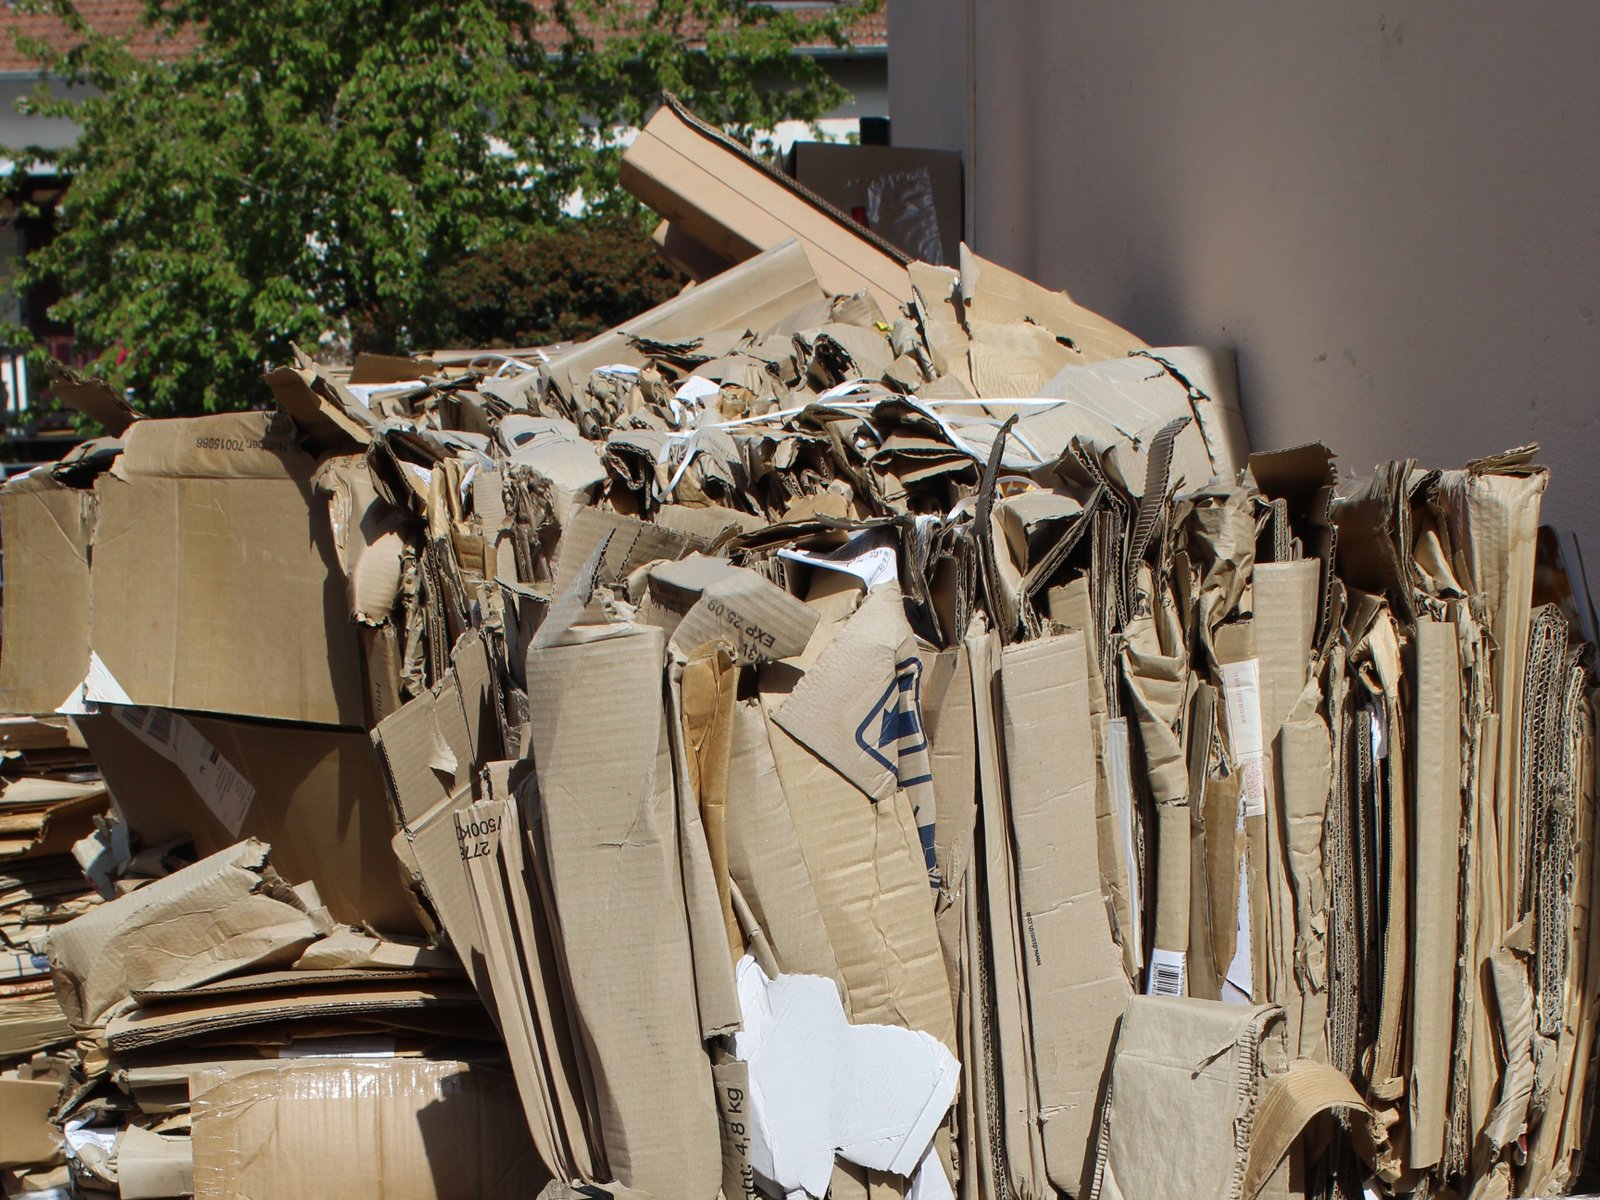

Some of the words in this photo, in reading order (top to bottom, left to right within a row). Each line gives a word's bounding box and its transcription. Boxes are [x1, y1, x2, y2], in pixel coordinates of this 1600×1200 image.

[196, 438, 244, 452] 70015986
[746, 626, 776, 648] EXP
[1026, 911, 1042, 967] www.dssmith.com
[727, 1087, 744, 1114] kg
[731, 1122, 751, 1157] 4,8
